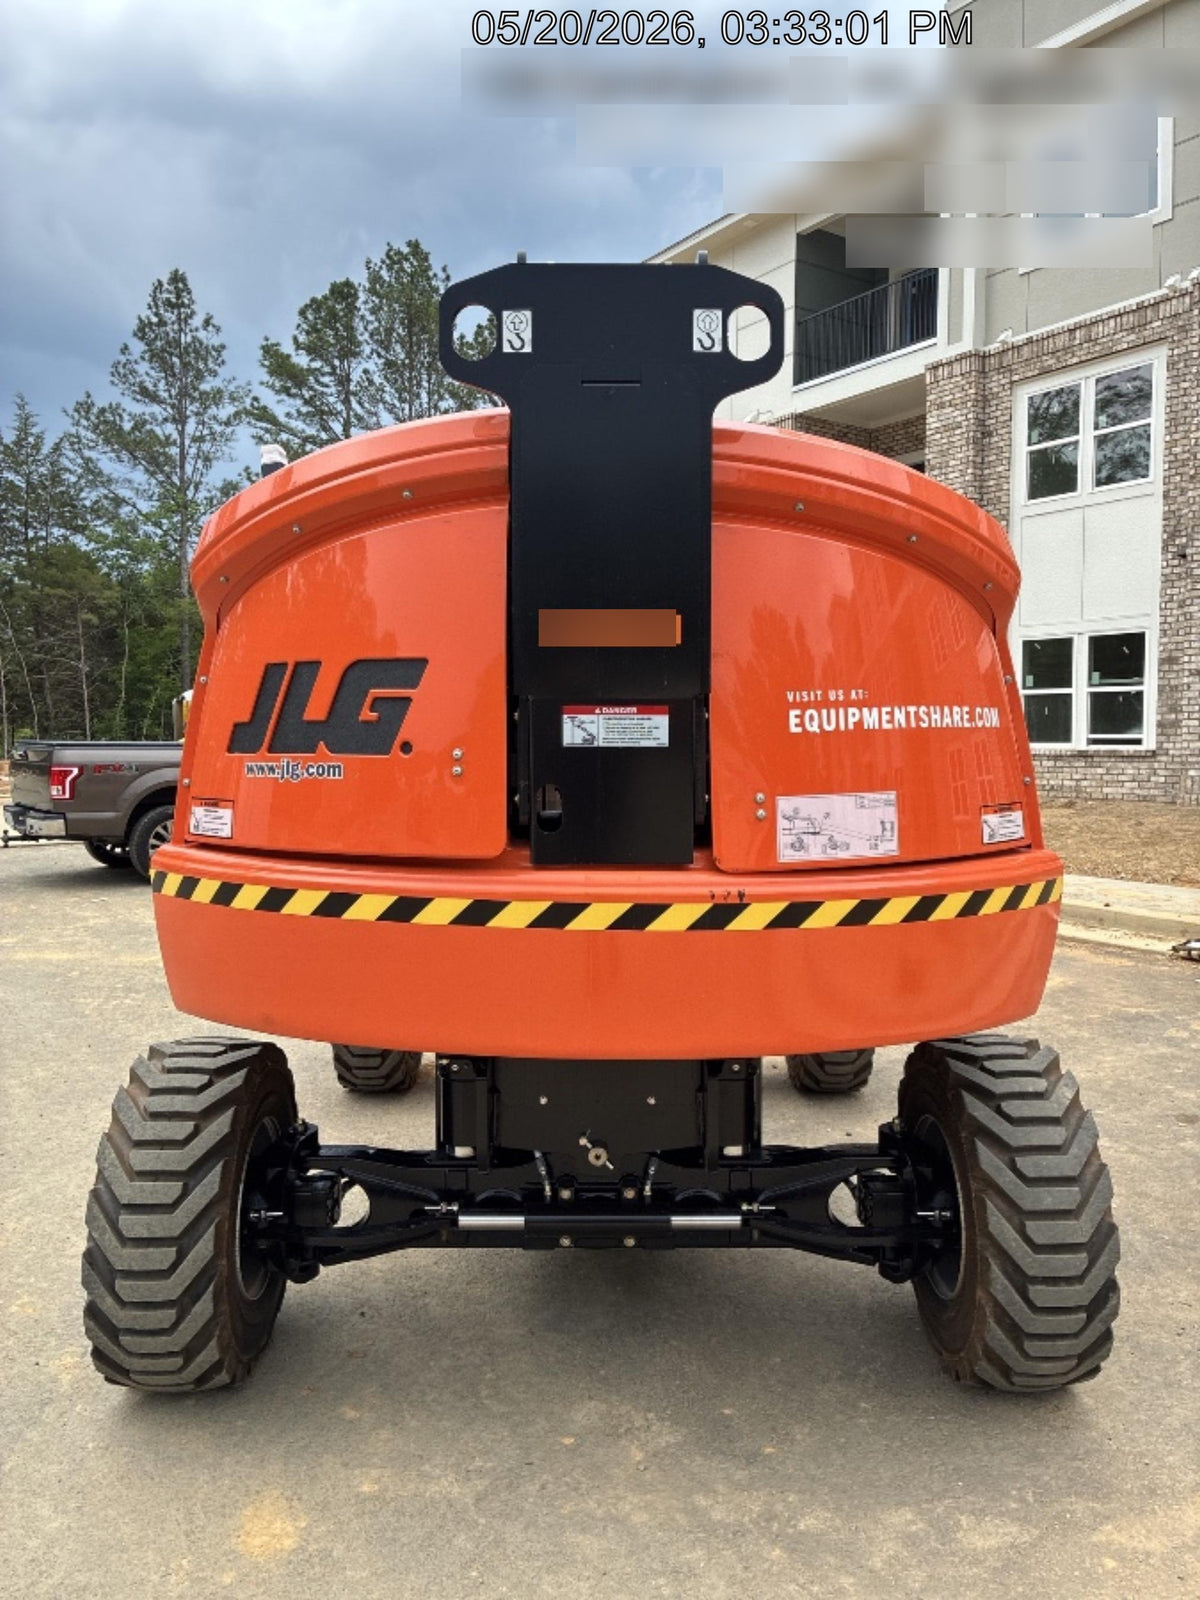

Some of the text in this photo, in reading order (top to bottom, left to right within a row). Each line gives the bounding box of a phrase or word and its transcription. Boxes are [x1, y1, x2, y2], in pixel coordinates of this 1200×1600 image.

[787, 689, 869, 702] VISIT US AT:
[602, 706, 637, 714] DANGER
[788, 705, 1000, 734] EQUIPMENTSHARE.COM
[245, 759, 343, 781] www.jlg.com
